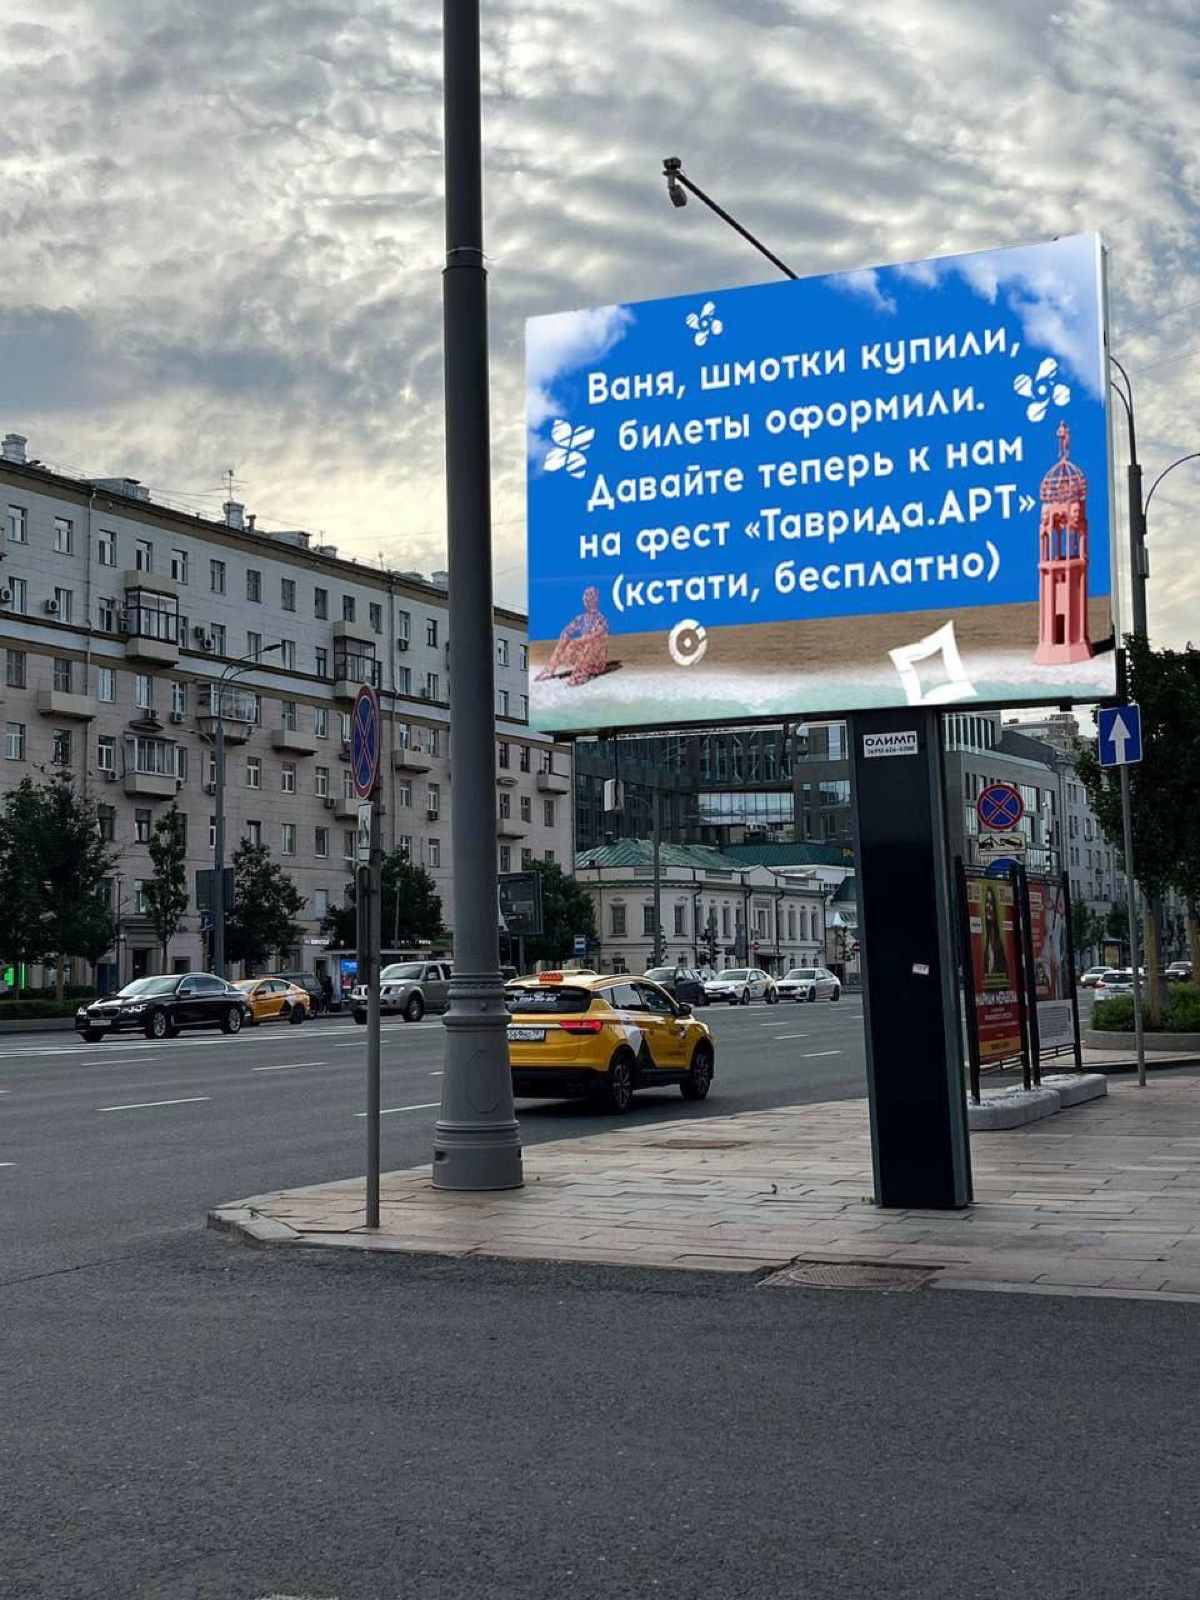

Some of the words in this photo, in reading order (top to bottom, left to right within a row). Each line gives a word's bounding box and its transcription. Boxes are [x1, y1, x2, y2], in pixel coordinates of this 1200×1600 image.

[588, 371, 685, 405] Ваня,
[700, 348, 845, 391] шмотки
[861, 327, 1020, 375] купили,
[619, 413, 750, 451] билеты
[765, 386, 985, 438] оформили.
[587, 464, 744, 512] Давайте
[758, 452, 894, 488] теперь
[909, 446, 931, 473] к
[946, 436, 1023, 469] нам
[579, 532, 621, 559] на
[635, 521, 731, 560] фест
[744, 484, 1036, 543] «Таврида.АРТ»
[612, 573, 760, 612] (кстати,
[775, 540, 1001, 594] бесплатно)
[865, 735, 915, 746] ОЛИМП
